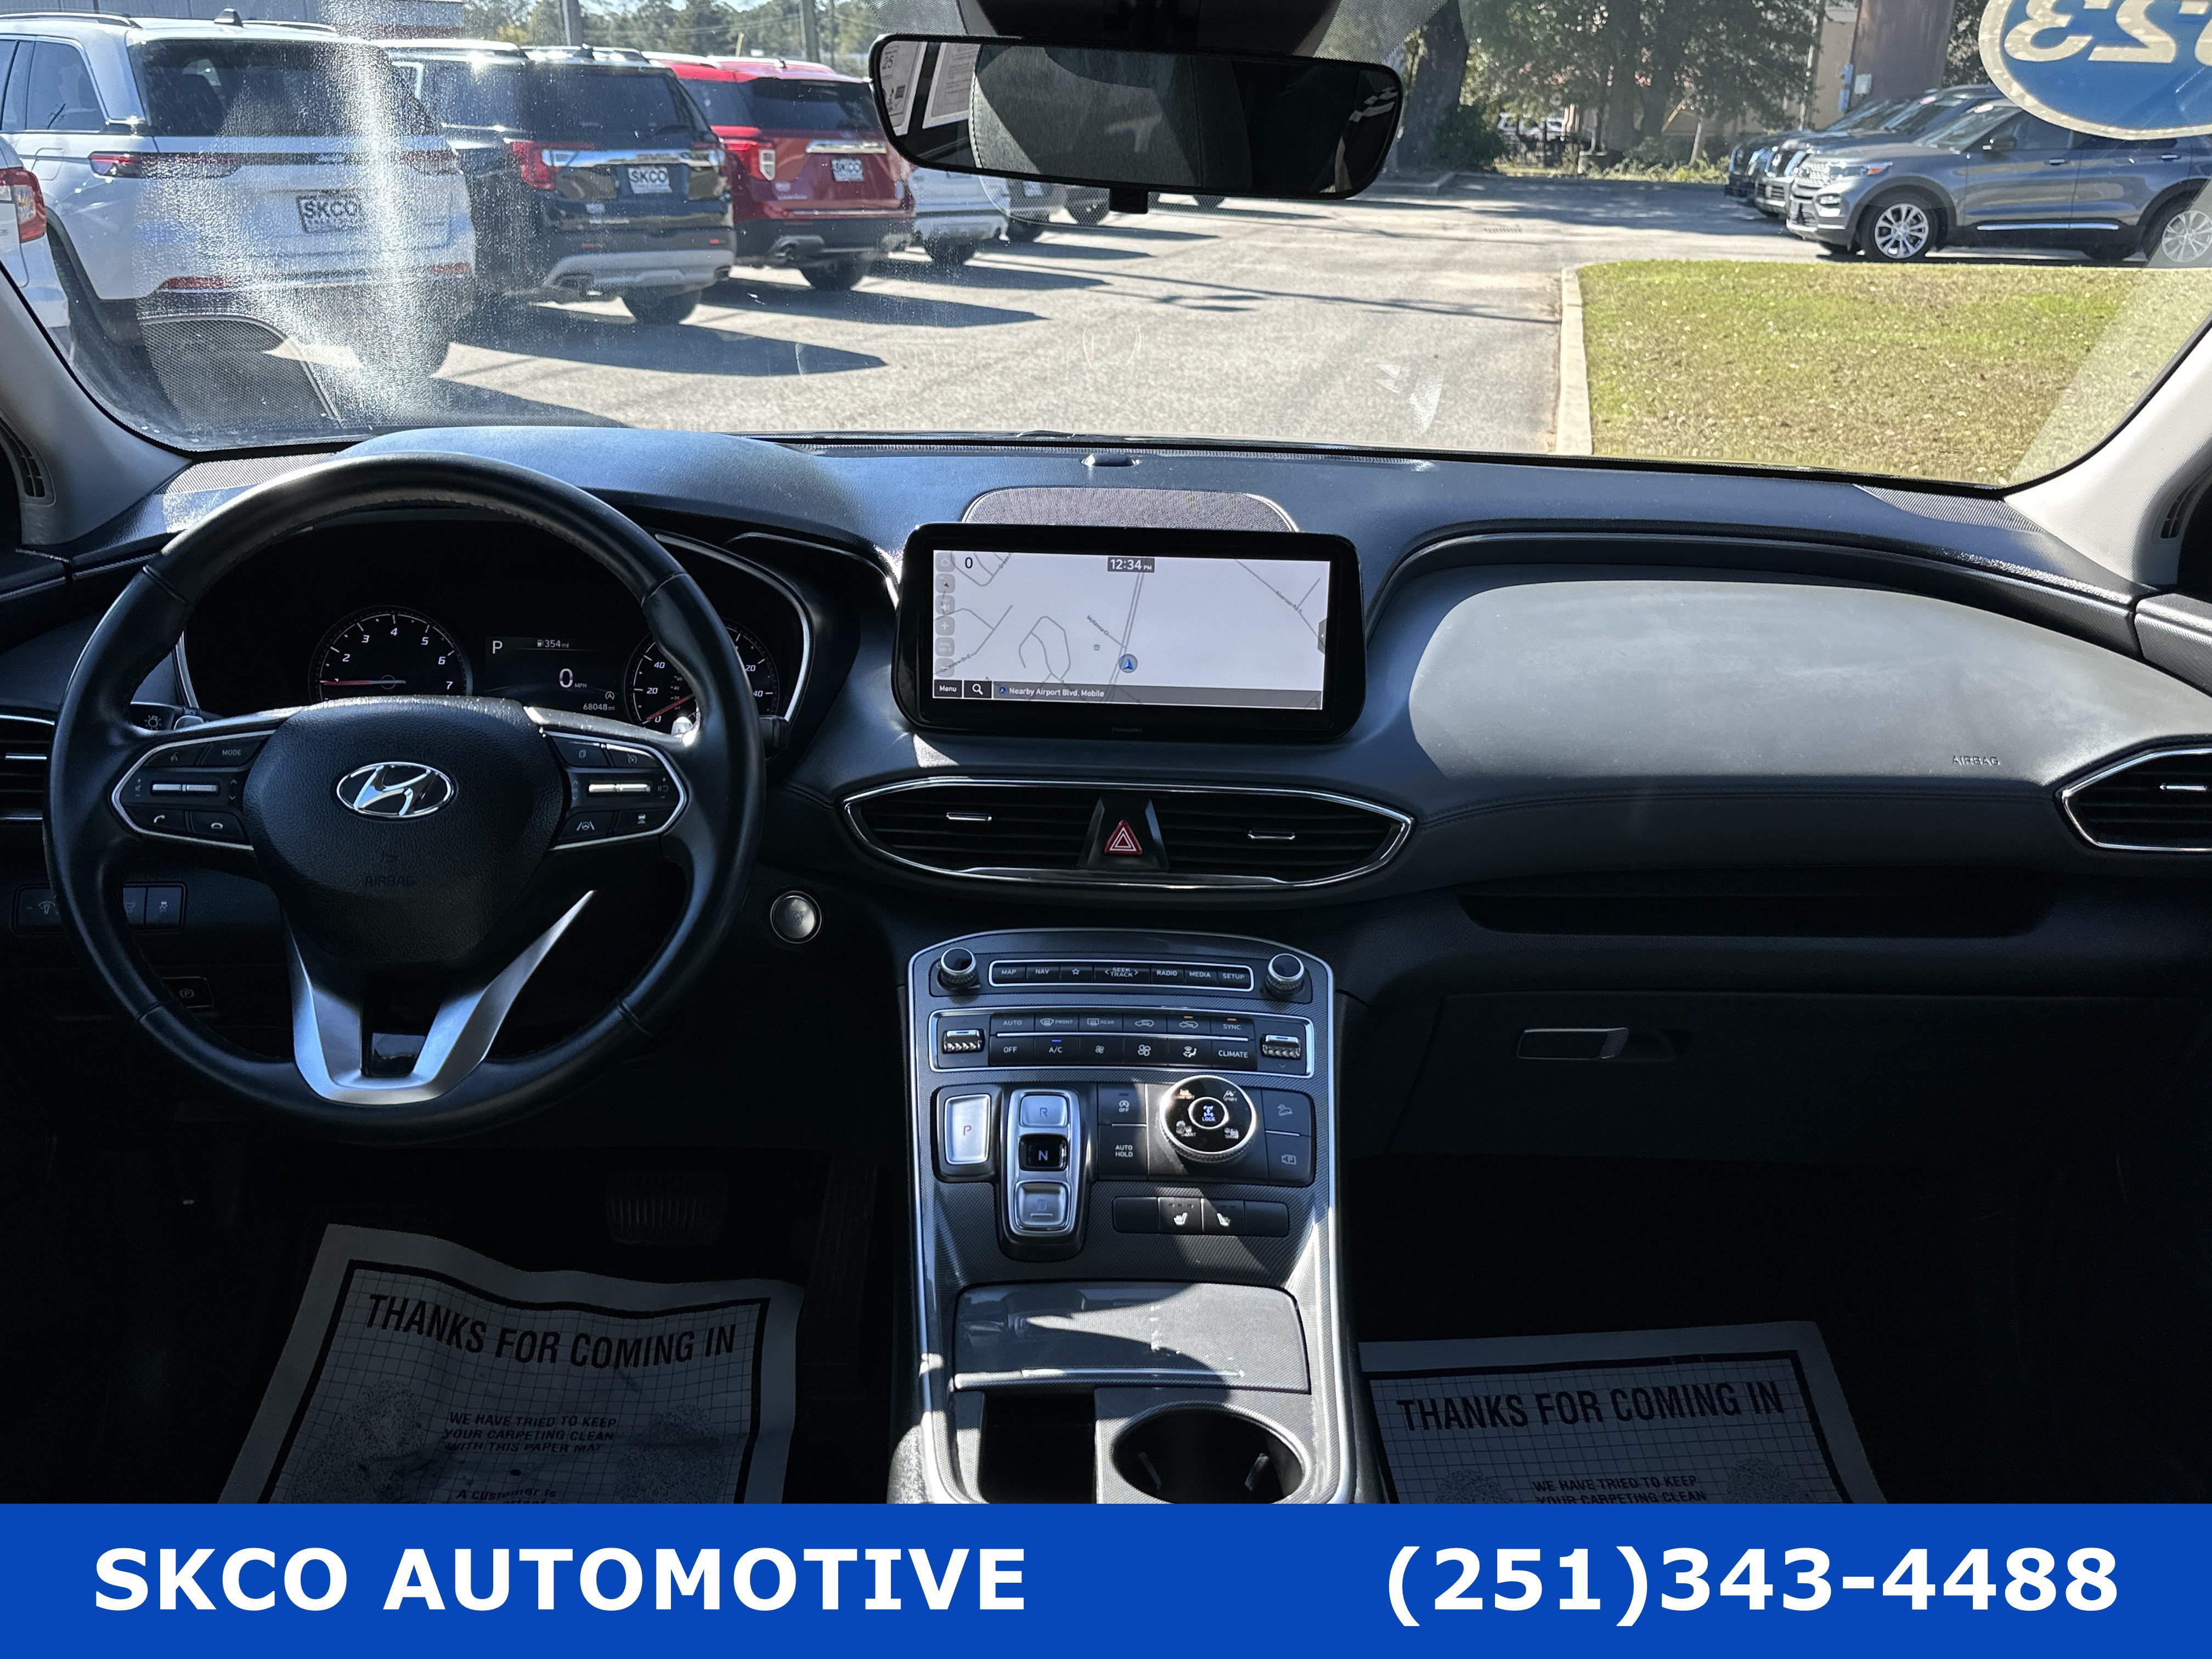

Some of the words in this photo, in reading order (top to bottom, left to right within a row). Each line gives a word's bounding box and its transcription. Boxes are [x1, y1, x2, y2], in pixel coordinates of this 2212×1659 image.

[631, 170, 667, 183] SKCO
[303, 200, 359, 219] SKCO
[964, 556, 973, 569] 0
[1110, 558, 1142, 571] 12:34
[390, 627, 398, 636] 4
[361, 634, 370, 644] 3
[421, 636, 429, 646] 5
[492, 640, 503, 654] P
[342, 653, 351, 662] 2
[438, 656, 446, 665] 6
[559, 668, 573, 688] 0
[445, 681, 453, 690] 7
[1009, 687, 1035, 696] Nearby
[1036, 689, 1061, 697] Airport
[1952, 755, 2000, 766] AIRBAG
[364, 875, 415, 888] AIRBAG
[1218, 1049, 1249, 1058] CLIMATE
[1039, 1107, 1048, 1118] R
[963, 1125, 972, 1136] P
[1038, 1149, 1048, 1161] N
[365, 1294, 487, 1354] THANKS
[495, 1327, 561, 1364] FOR
[570, 1330, 695, 1370] COMING
[704, 1324, 737, 1358] IN
[1396, 1394, 1528, 1431] THANKS
[1534, 1390, 1604, 1426] FOR
[1610, 1382, 1741, 1422] COMING
[1746, 1380, 1785, 1414] IN
[449, 1411, 472, 1425] WE
[475, 1413, 511, 1426] HAVE
[516, 1416, 555, 1427] TRIED
[561, 1415, 578, 1426] TO
[582, 1416, 617, 1429] KEEP
[444, 1428, 483, 1440] YOUR
[487, 1429, 565, 1441] CARPETING
[569, 1431, 614, 1441] CLEAN
[444, 1441, 483, 1452] WITH
[488, 1442, 519, 1452] THIS
[524, 1443, 569, 1453] PAPER
[573, 1443, 602, 1453] MAT
[1532, 1480, 1557, 1492] WE
[1558, 1479, 1596, 1492] HAVE
[1596, 1477, 1639, 1490] TRIED
[1641, 1476, 1661, 1488] TO
[1662, 1475, 1698, 1487] KEEP
[456, 1489, 467, 1499] A
[1579, 1492, 1658, 1504] CARPETING
[1661, 1491, 1708, 1503] CLEAN
